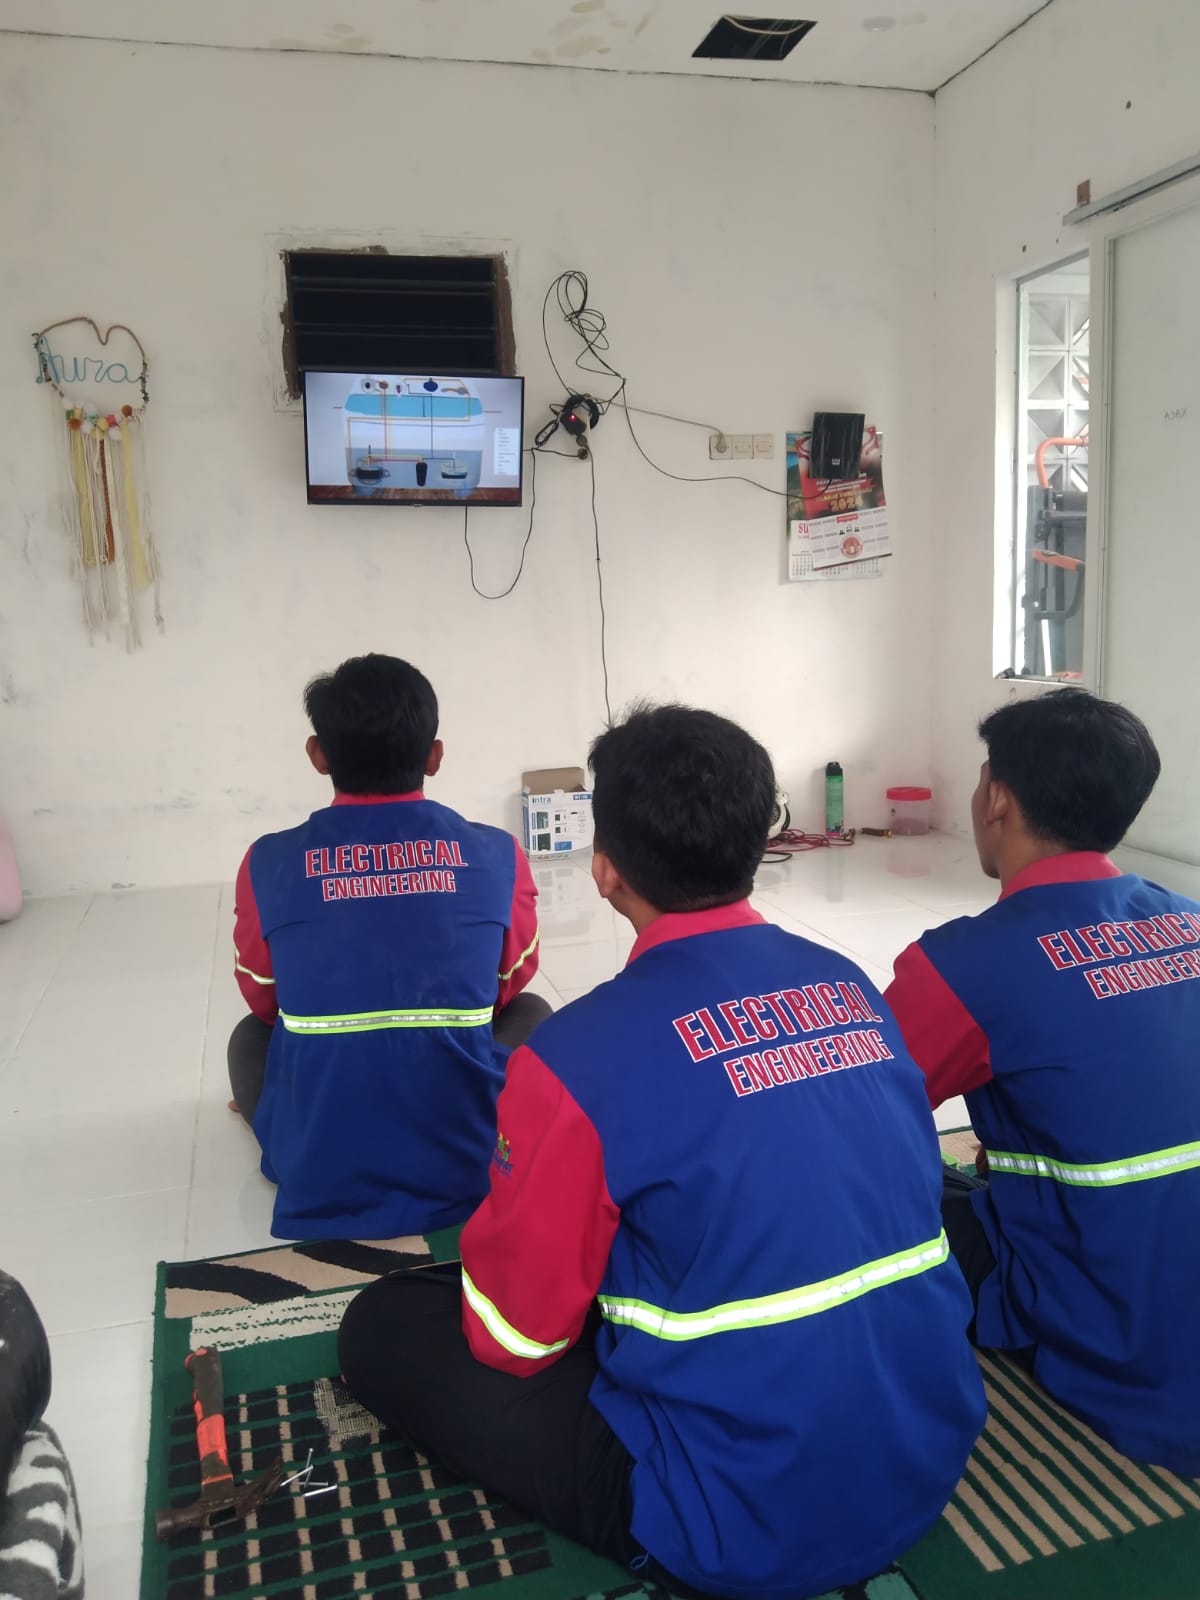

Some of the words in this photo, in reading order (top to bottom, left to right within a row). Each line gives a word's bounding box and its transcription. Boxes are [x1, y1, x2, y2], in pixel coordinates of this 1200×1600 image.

[305, 840, 469, 878] ELECTRICAL
[322, 870, 456, 902] ENGINEERING
[1037, 912, 1200, 971] ELECTRICA
[672, 981, 883, 1063] ELECTRICAL
[723, 1029, 894, 1098] ENGINEERING
